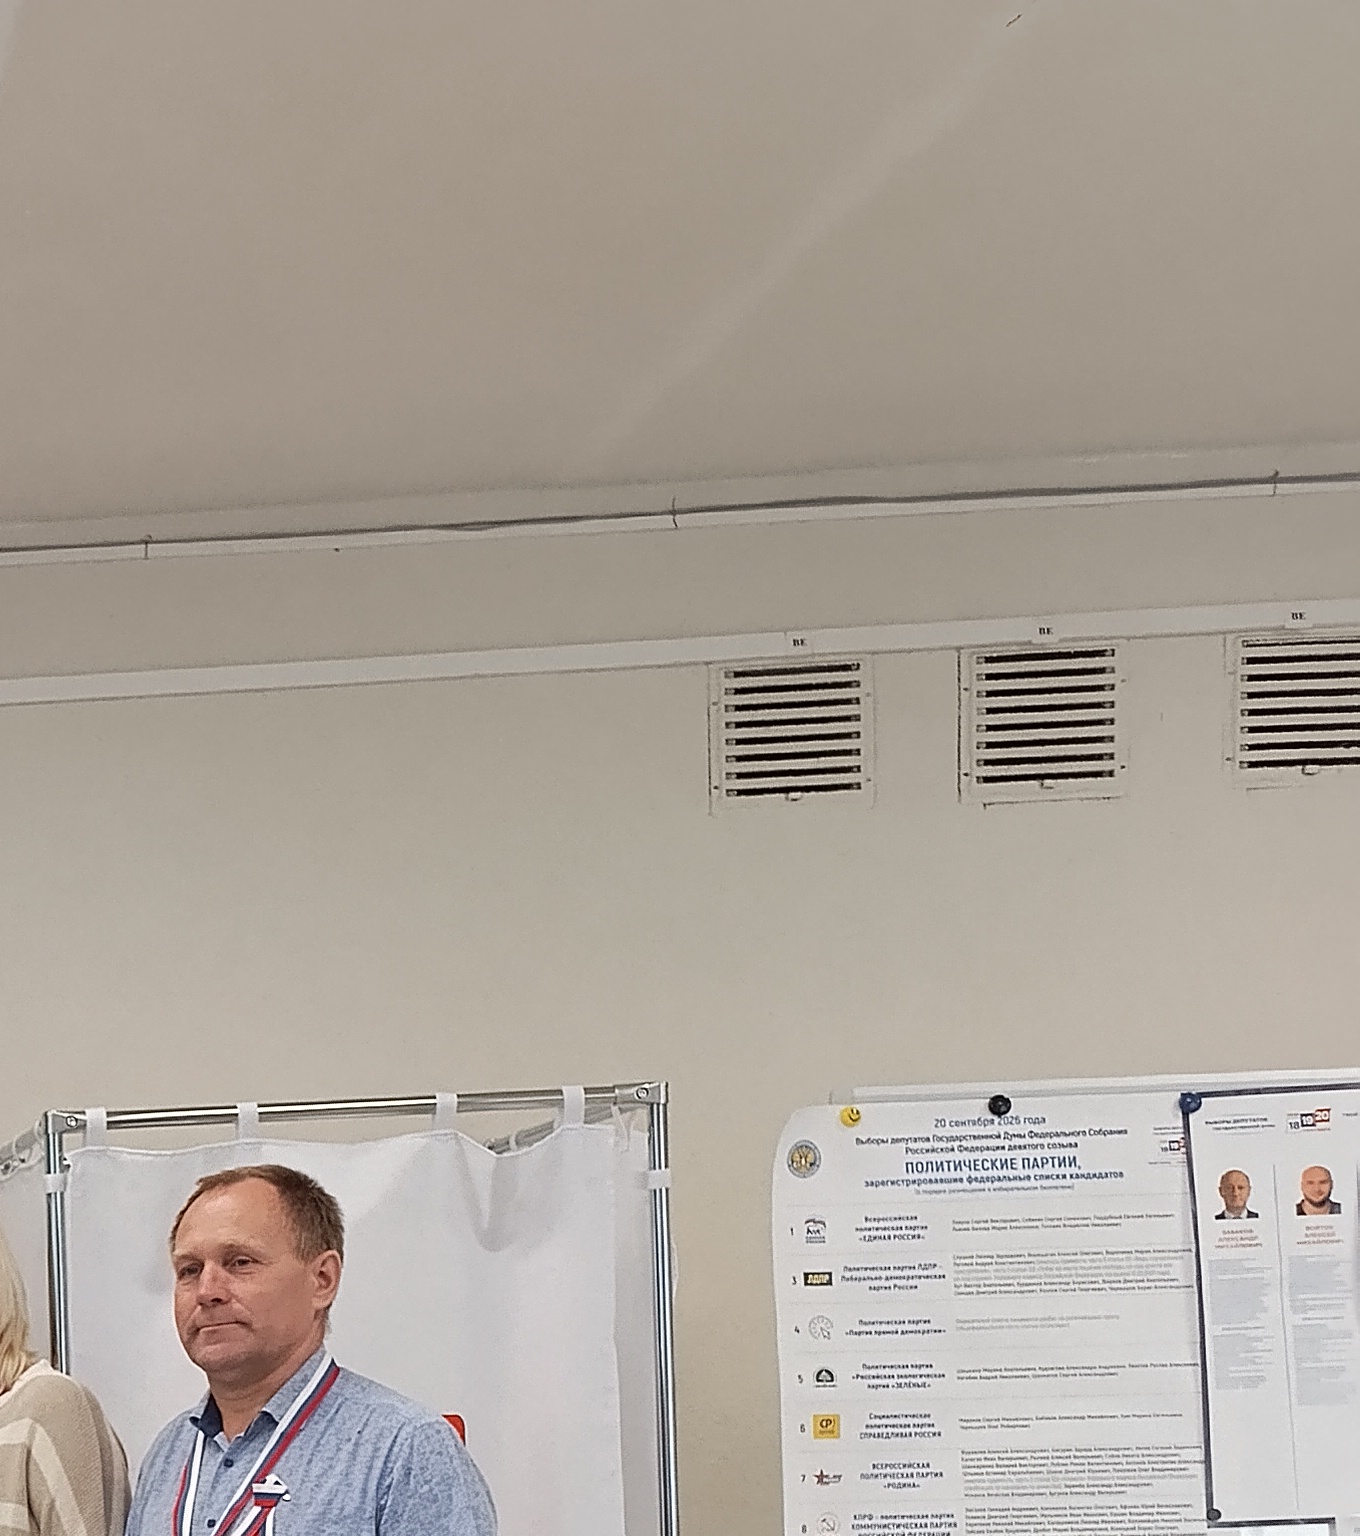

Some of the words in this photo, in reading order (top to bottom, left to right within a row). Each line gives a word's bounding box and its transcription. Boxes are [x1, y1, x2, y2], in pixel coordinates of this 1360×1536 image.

[934, 1118, 947, 1128] 20
[949, 1115, 995, 1128] сентября
[997, 1115, 1021, 1126] 2026
[1023, 1115, 1046, 1125] года
[1289, 1121, 1300, 1130] 18
[1302, 1115, 1313, 1125] 19
[1315, 1110, 1329, 1120] 20
[855, 1137, 889, 1147] Выборы
[891, 1134, 930, 1145] депутатов
[932, 1130, 1001, 1144] Государственной
[1003, 1131, 1026, 1141] Думы
[1028, 1128, 1087, 1140] Федерального
[1088, 1127, 1128, 1137] Собрания
[905, 1145, 955, 1156] Российской
[957, 1144, 1006, 1155] Федерации
[1007, 1142, 1044, 1152] девятого
[1045, 1140, 1079, 1150] созыва
[905, 1157, 1018, 1175] ПОЛИТИЧЕСКИЕ
[1021, 1155, 1082, 1171] ПАРТИИ,
[864, 1176, 964, 1189] зарегистрировавшие
[966, 1173, 1031, 1186] федеральные
[1033, 1171, 1068, 1182] списки
[1069, 1170, 1125, 1181] кандидатов
[864, 1215, 919, 1223] Всероссийская
[855, 1225, 903, 1233] политическая
[904, 1224, 928, 1233] партия
[843, 1265, 891, 1273] Политическая
[892, 1264, 916, 1272] партия
[917, 1263, 937, 1271] ЛДПР
[868, 1285, 892, 1293] партия
[892, 1283, 918, 1291] России
[858, 1319, 906, 1327] Политическая
[907, 1318, 931, 1326] партия
[862, 1363, 909, 1371] Политическая
[910, 1362, 934, 1370] партия
[867, 1383, 890, 1391] партия
[800, 1423, 806, 1433] 6
[912, 1422, 935, 1430] партия
[859, 1431, 913, 1441] СПРАВЕДЛИВАЯ
[913, 1430, 942, 1439] РОССИЯ
[871, 1461, 931, 1470] ВСЕРОССИЙСКАЯ
[859, 1472, 914, 1481] ПОЛИТИЧЕСКАЯ
[915, 1471, 944, 1479] ПАРТИЯ
[853, 1513, 874, 1521] КПРФ
[930, 1512, 955, 1521] партия
[851, 1522, 928, 1531] КОММУНИСТИЧЕСКАЯ
[929, 1521, 958, 1529] ПАРТИЯ
